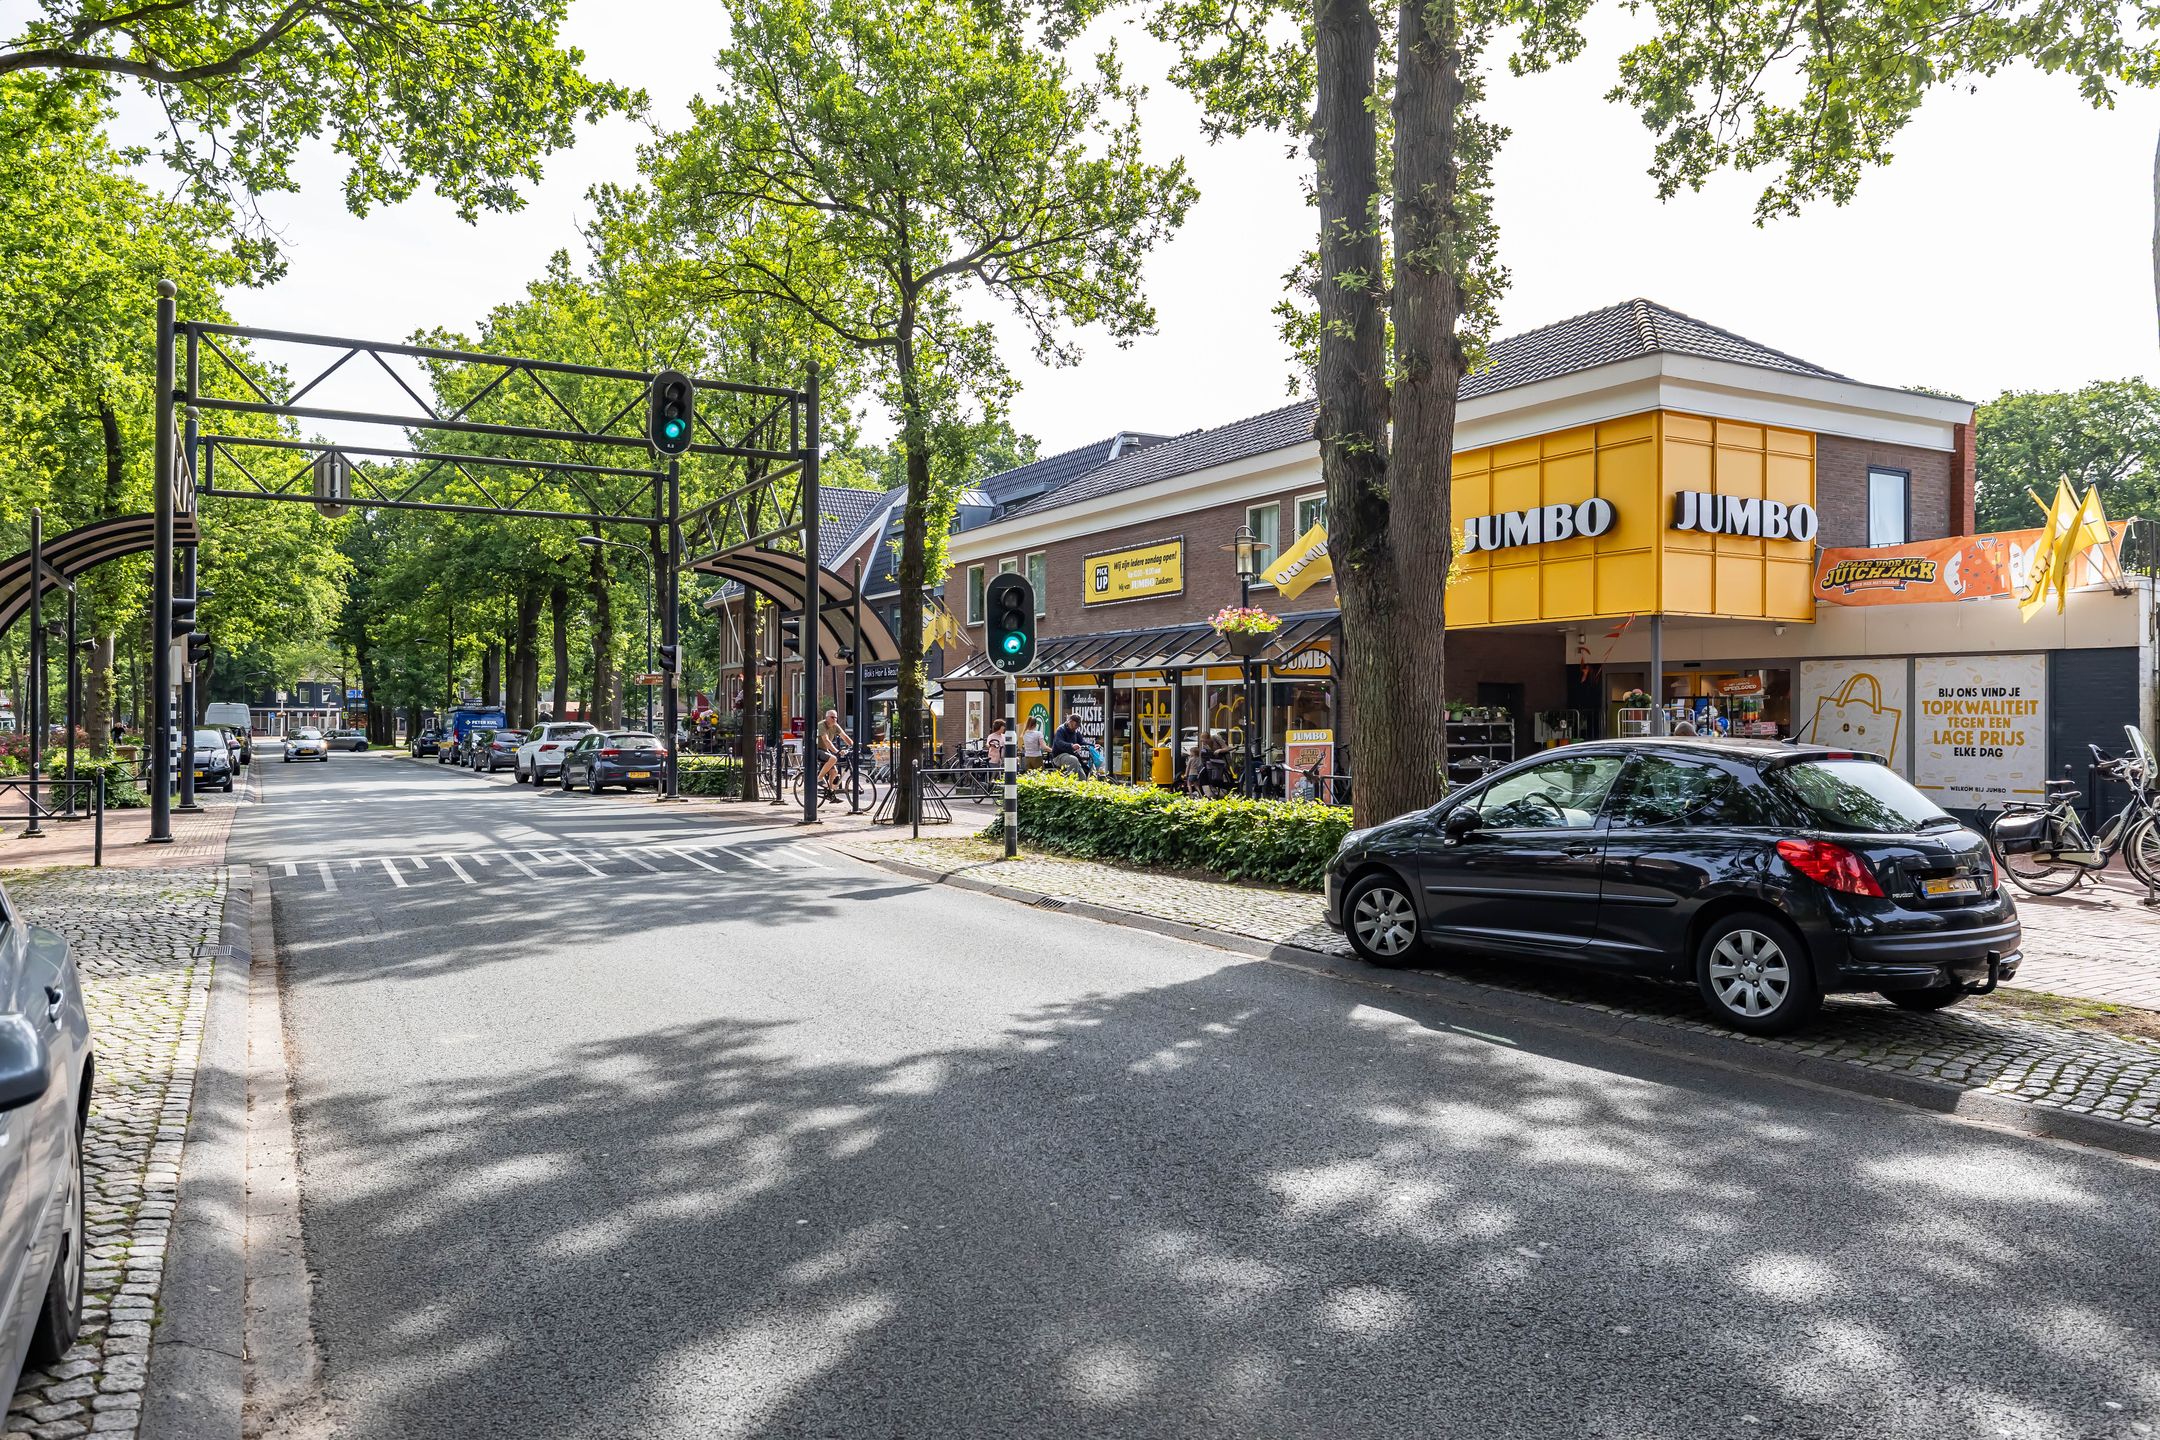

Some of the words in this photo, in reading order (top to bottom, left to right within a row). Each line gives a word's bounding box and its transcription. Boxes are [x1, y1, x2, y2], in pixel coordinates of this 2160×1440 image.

[1677, 490, 1819, 542] JUMBO
[1461, 497, 1614, 554] JUMBO
[1121, 559, 1130, 570] zijn
[1130, 558, 1144, 568] iedere
[1144, 554, 1162, 566] zondag
[1162, 551, 1178, 563] open!
[1839, 560, 1873, 569] SPAAR
[1875, 559, 1902, 568] VOOR
[1096, 567, 1108, 576] PICK
[1822, 561, 1936, 588] JUICHJACK
[1096, 576, 1108, 590] UP
[1131, 578, 1155, 590] JUMBO
[1938, 688, 1954, 698] BIJ
[1956, 687, 1978, 697] ONS
[1981, 687, 2007, 697] VIND
[2008, 687, 2021, 697] JE
[1922, 699, 2039, 715] TOPKWALITEIT
[1947, 716, 1985, 729] TEGEN
[1989, 717, 2011, 729] EEN
[1292, 731, 1328, 741] JUMBO
[1933, 730, 1974, 746] LAGE
[1980, 731, 2025, 747] PRIJS
[1953, 747, 1977, 757] ELKE
[1979, 747, 2003, 758] DAG
